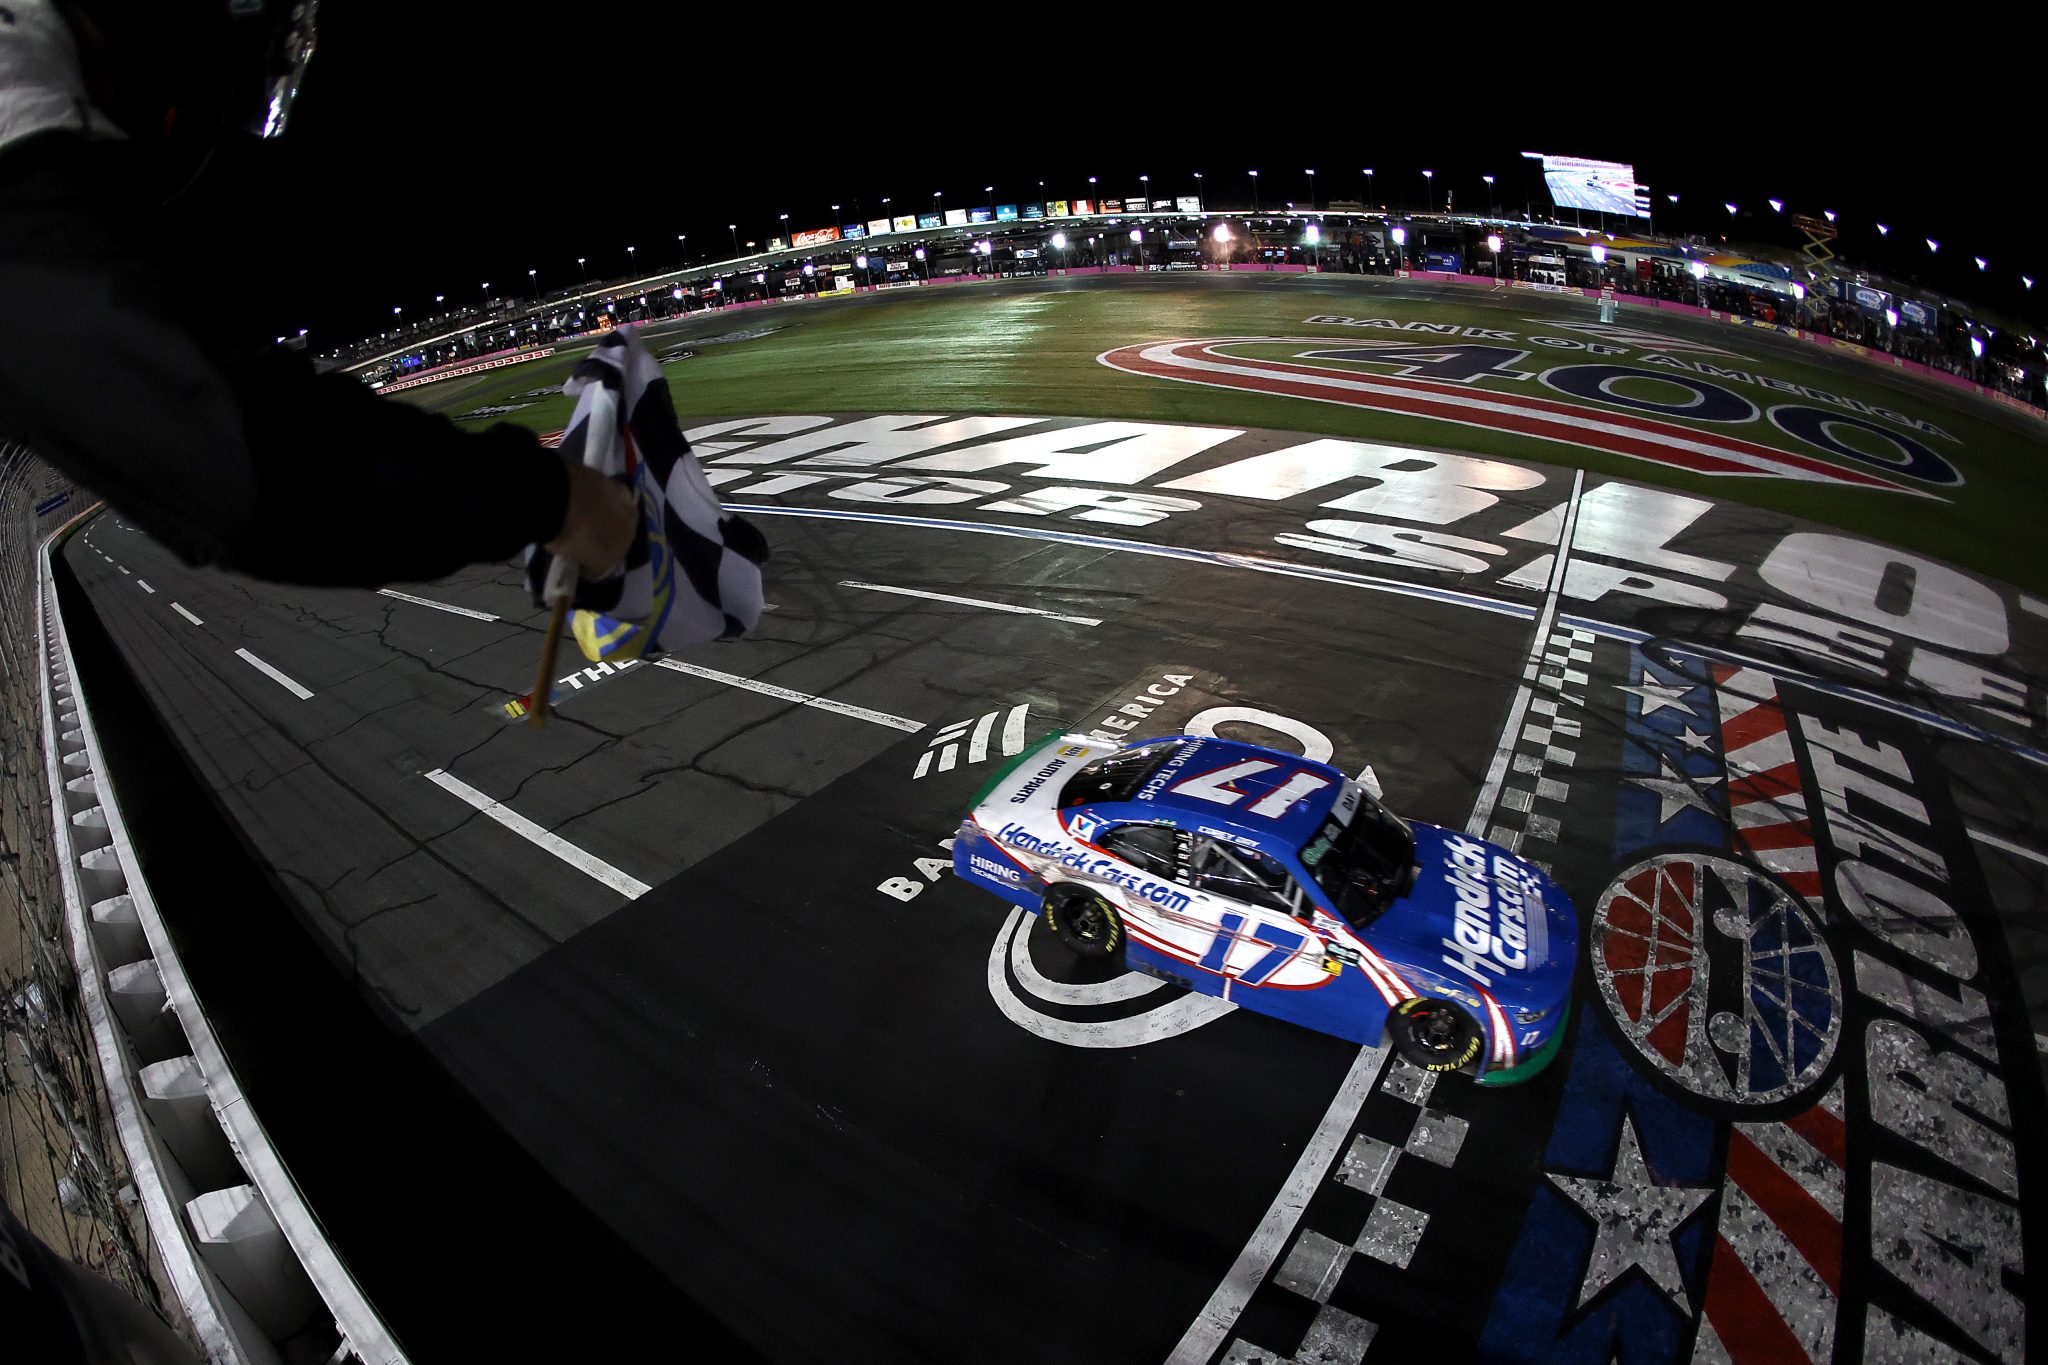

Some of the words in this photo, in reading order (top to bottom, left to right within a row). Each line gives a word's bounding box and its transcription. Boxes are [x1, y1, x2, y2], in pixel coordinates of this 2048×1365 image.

[1292, 344, 1967, 487] 400
[1302, 315, 1518, 341] BANK
[1527, 336, 1630, 355] OF
[1637, 353, 1966, 446] AMERICA
[683, 415, 2048, 656] CHARLO
[1037, 758, 1067, 778] AUTO
[1138, 767, 1177, 800] TECHS
[1166, 757, 1333, 820] 17
[1168, 735, 1206, 768] HIRING
[1010, 776, 1048, 804] PARTS
[877, 828, 960, 902] BA
[969, 853, 1021, 882] HIRING
[1442, 834, 1507, 987] Hendrick
[1491, 855, 1528, 970] Cars.com
[1195, 911, 1310, 987] 17
